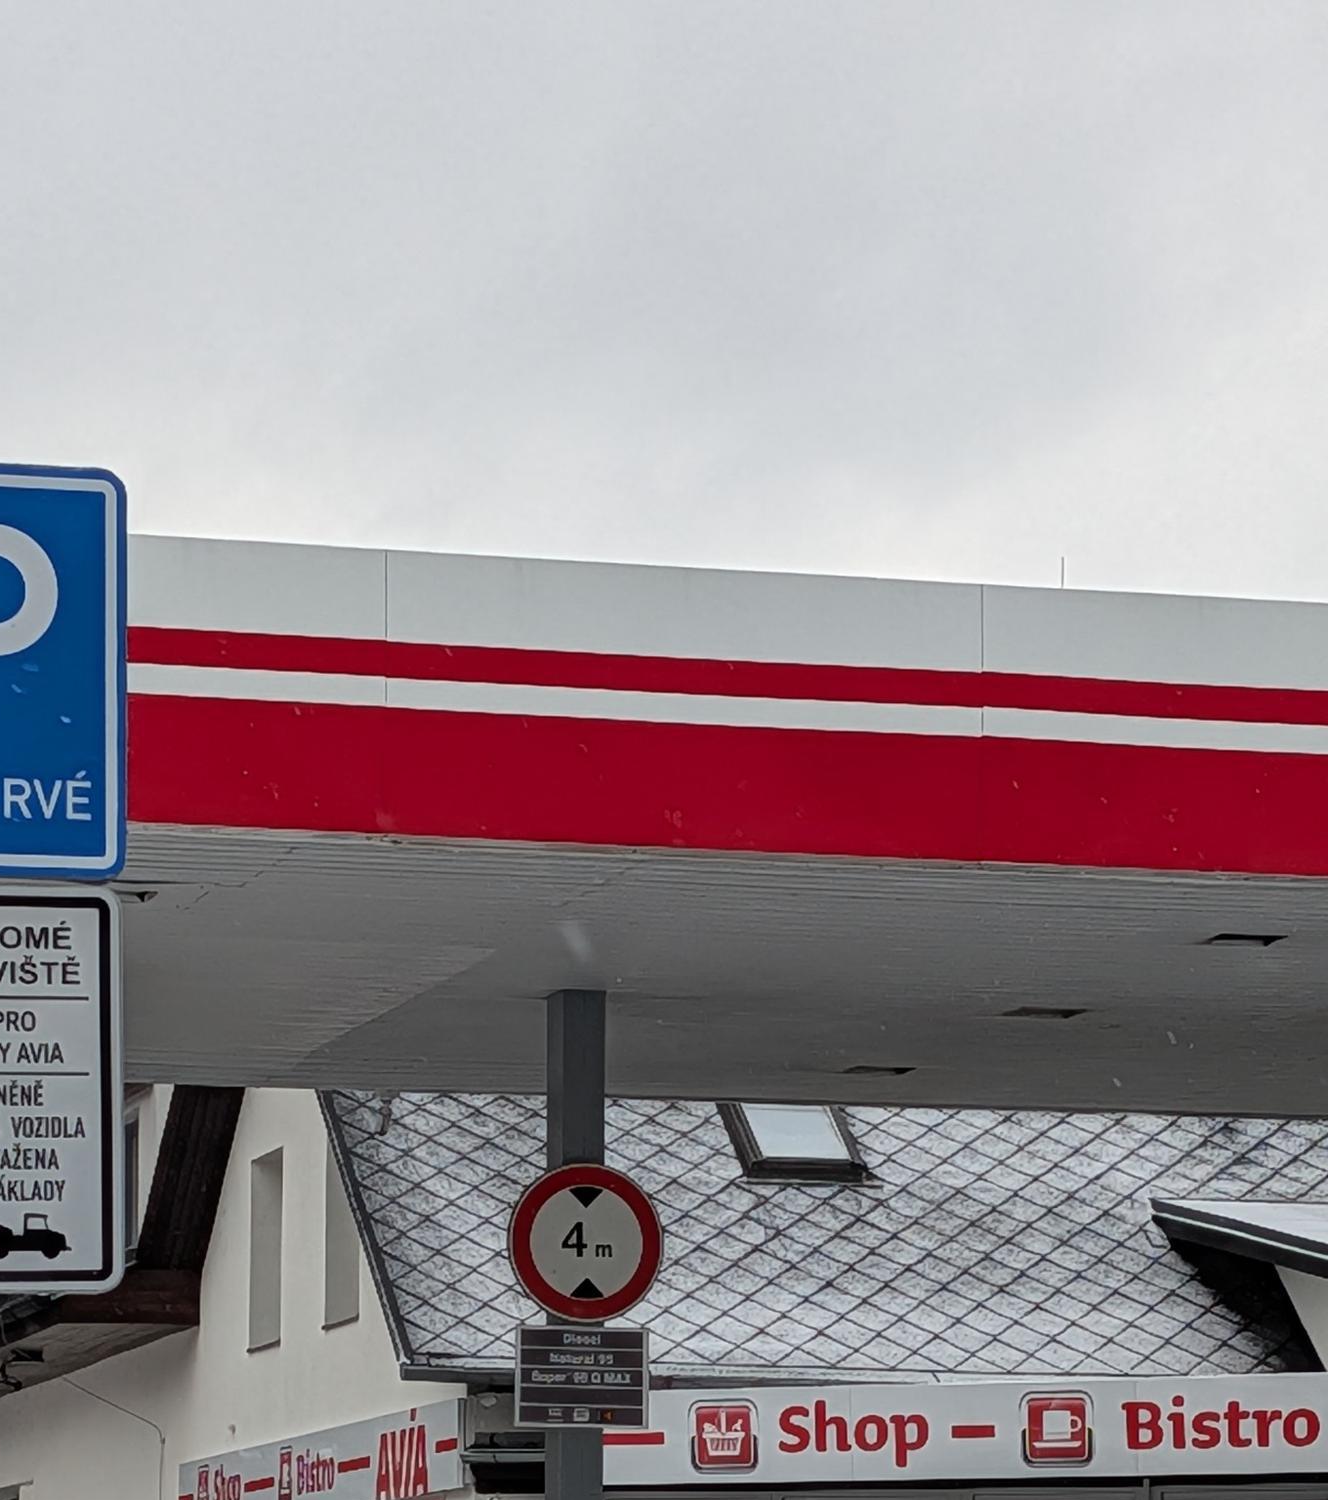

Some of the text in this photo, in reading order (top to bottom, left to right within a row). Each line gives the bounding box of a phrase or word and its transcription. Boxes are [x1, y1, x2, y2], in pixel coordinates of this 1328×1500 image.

[16, 1042, 65, 1065] AVIA
[11, 1115, 87, 1139] VOZIDLA
[561, 1221, 613, 1258] 4 m
[777, 1394, 1322, 1468] Shop Bistro
[295, 1449, 336, 1496] Bistro
